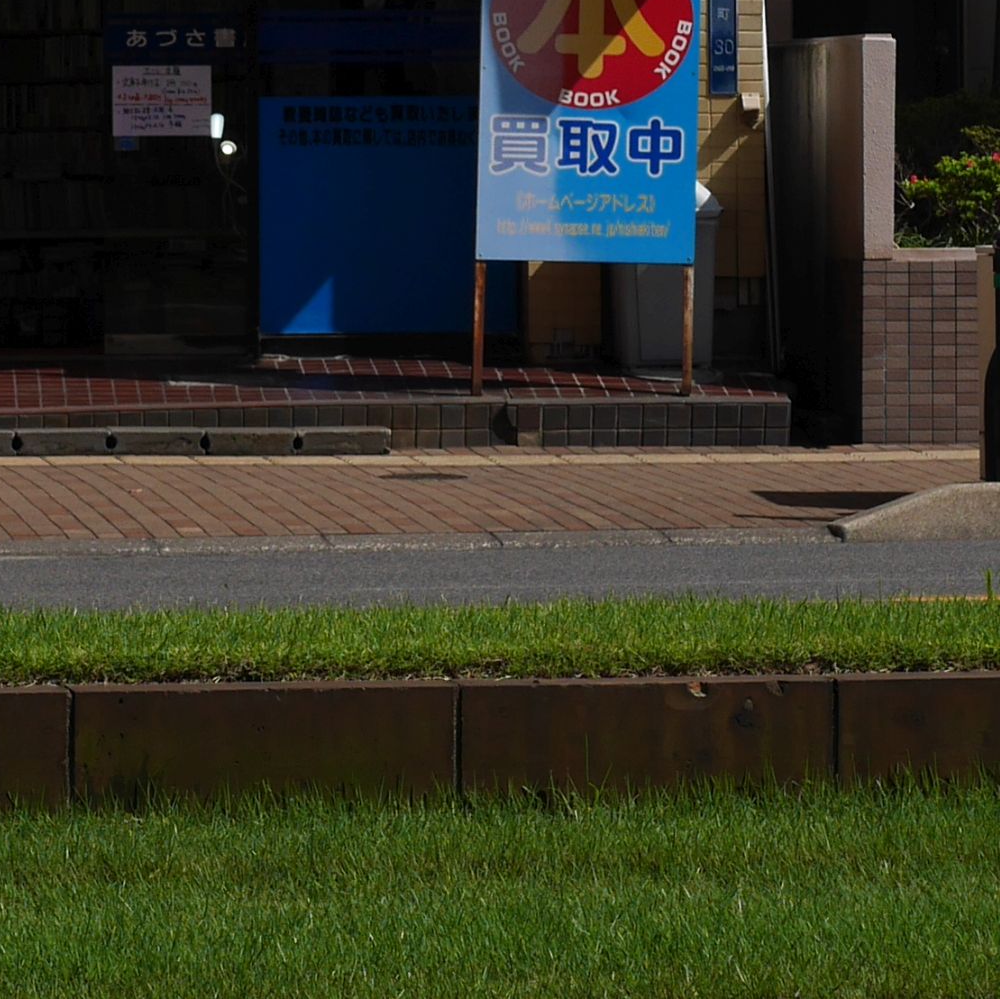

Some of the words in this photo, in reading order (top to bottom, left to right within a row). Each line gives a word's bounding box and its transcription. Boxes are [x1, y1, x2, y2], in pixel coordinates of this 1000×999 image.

[125, 28, 248, 49] あづさ書
[491, 11, 526, 73] BOOK
[657, 19, 694, 81] BOOK
[713, 39, 735, 56] 30
[559, 88, 621, 108] BOOK
[490, 114, 685, 179] 買取中
